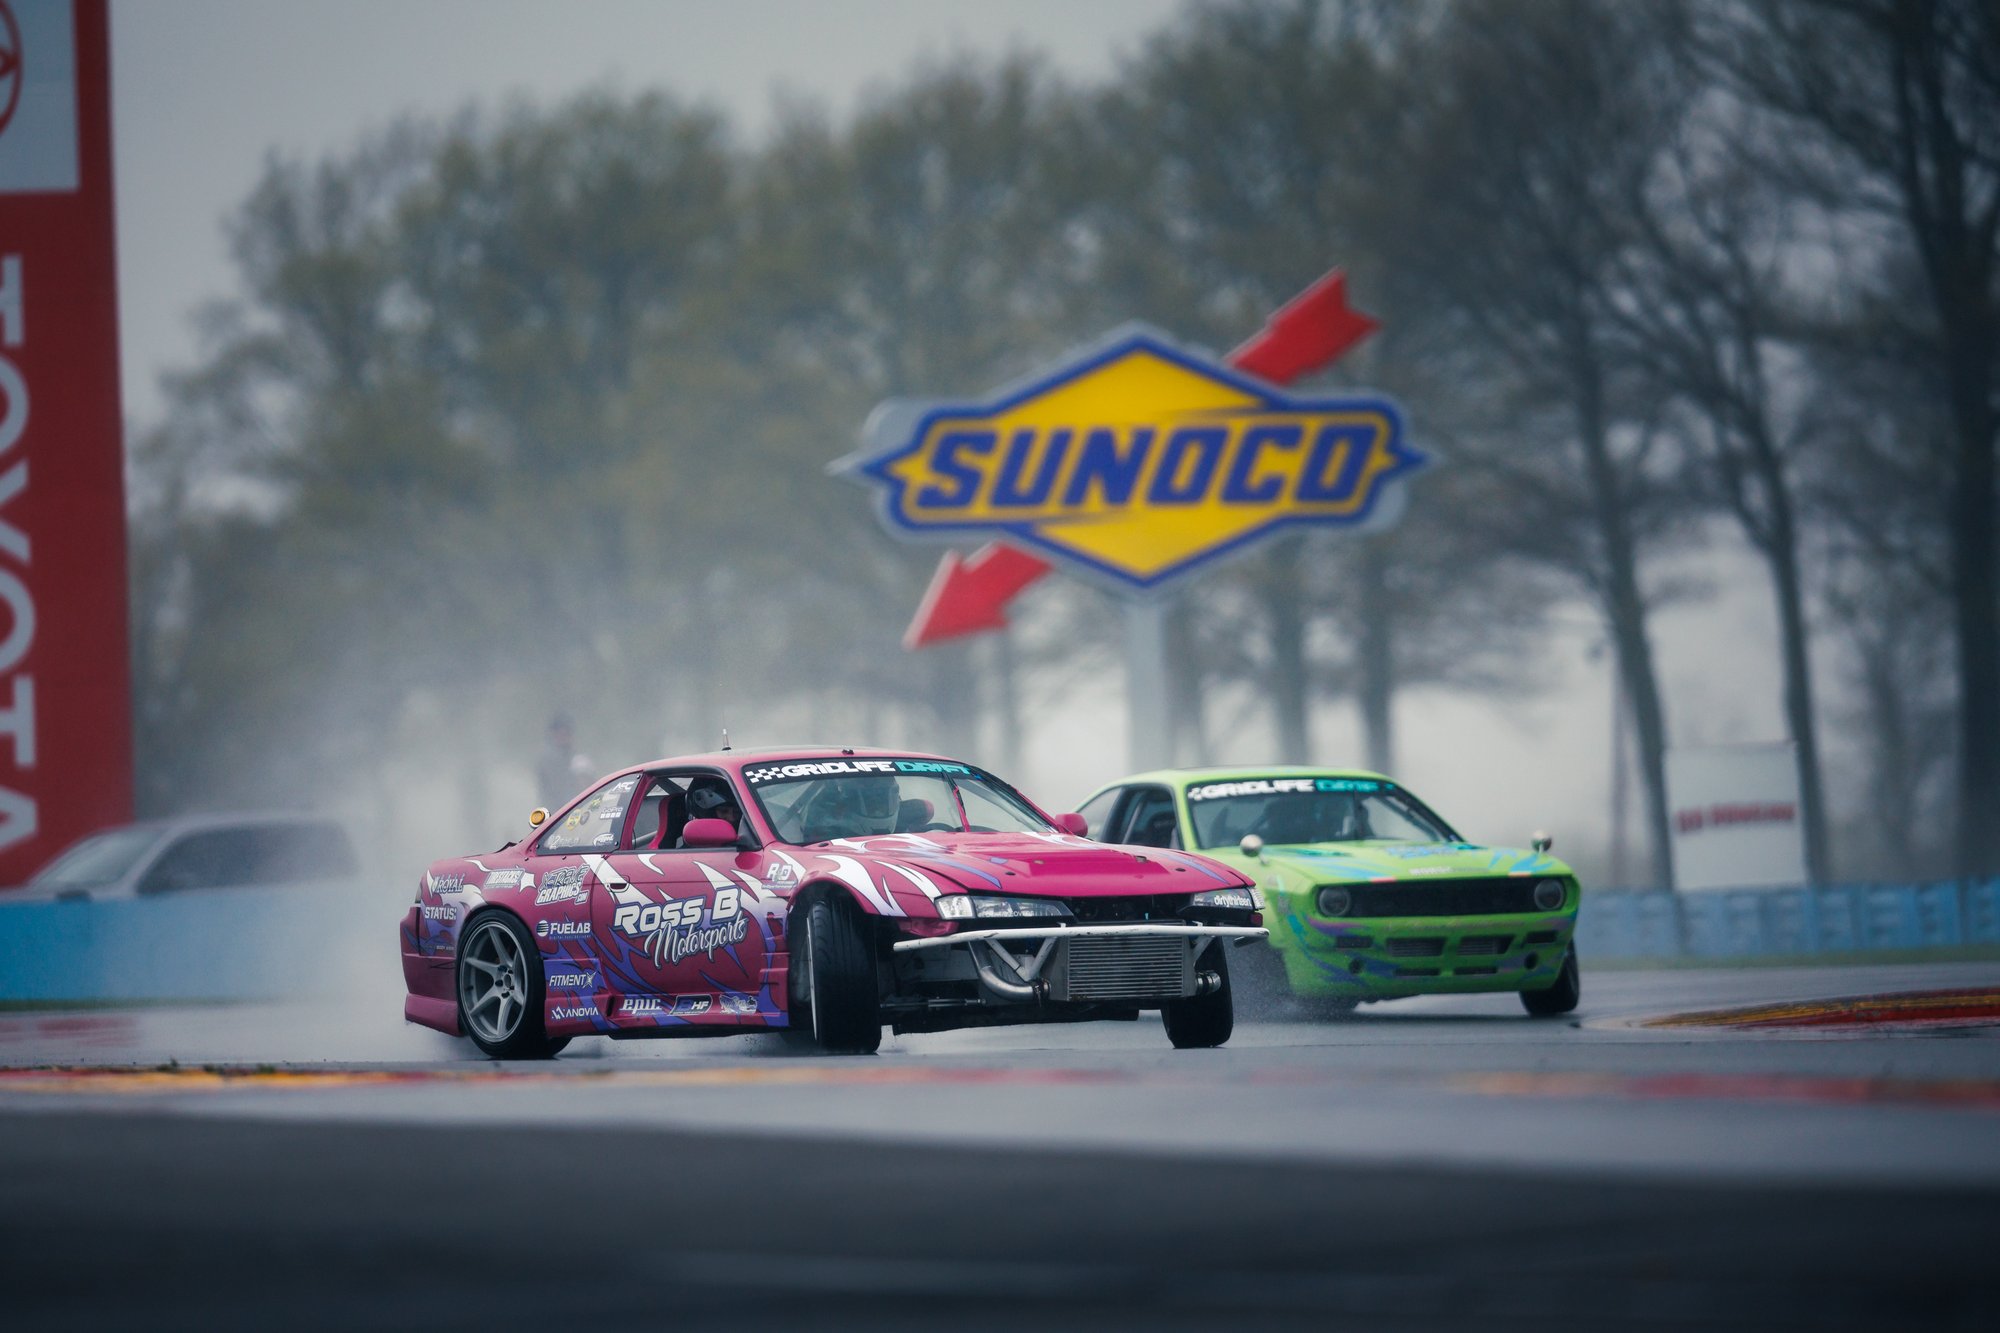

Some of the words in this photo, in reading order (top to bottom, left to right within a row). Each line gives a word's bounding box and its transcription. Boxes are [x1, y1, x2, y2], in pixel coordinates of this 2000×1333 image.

[915, 424, 1381, 508] SUNOCO
[781, 761, 895, 779] GRIDLIFE
[894, 761, 972, 777] DRIFT
[1202, 779, 1315, 799] GRIDLIFE
[536, 882, 581, 904] GRAPHICS
[614, 898, 704, 936] ROSS
[712, 888, 739, 921] B
[550, 922, 591, 935] FUELAB
[644, 911, 749, 969] Motorsports
[620, 998, 662, 1015] epic
